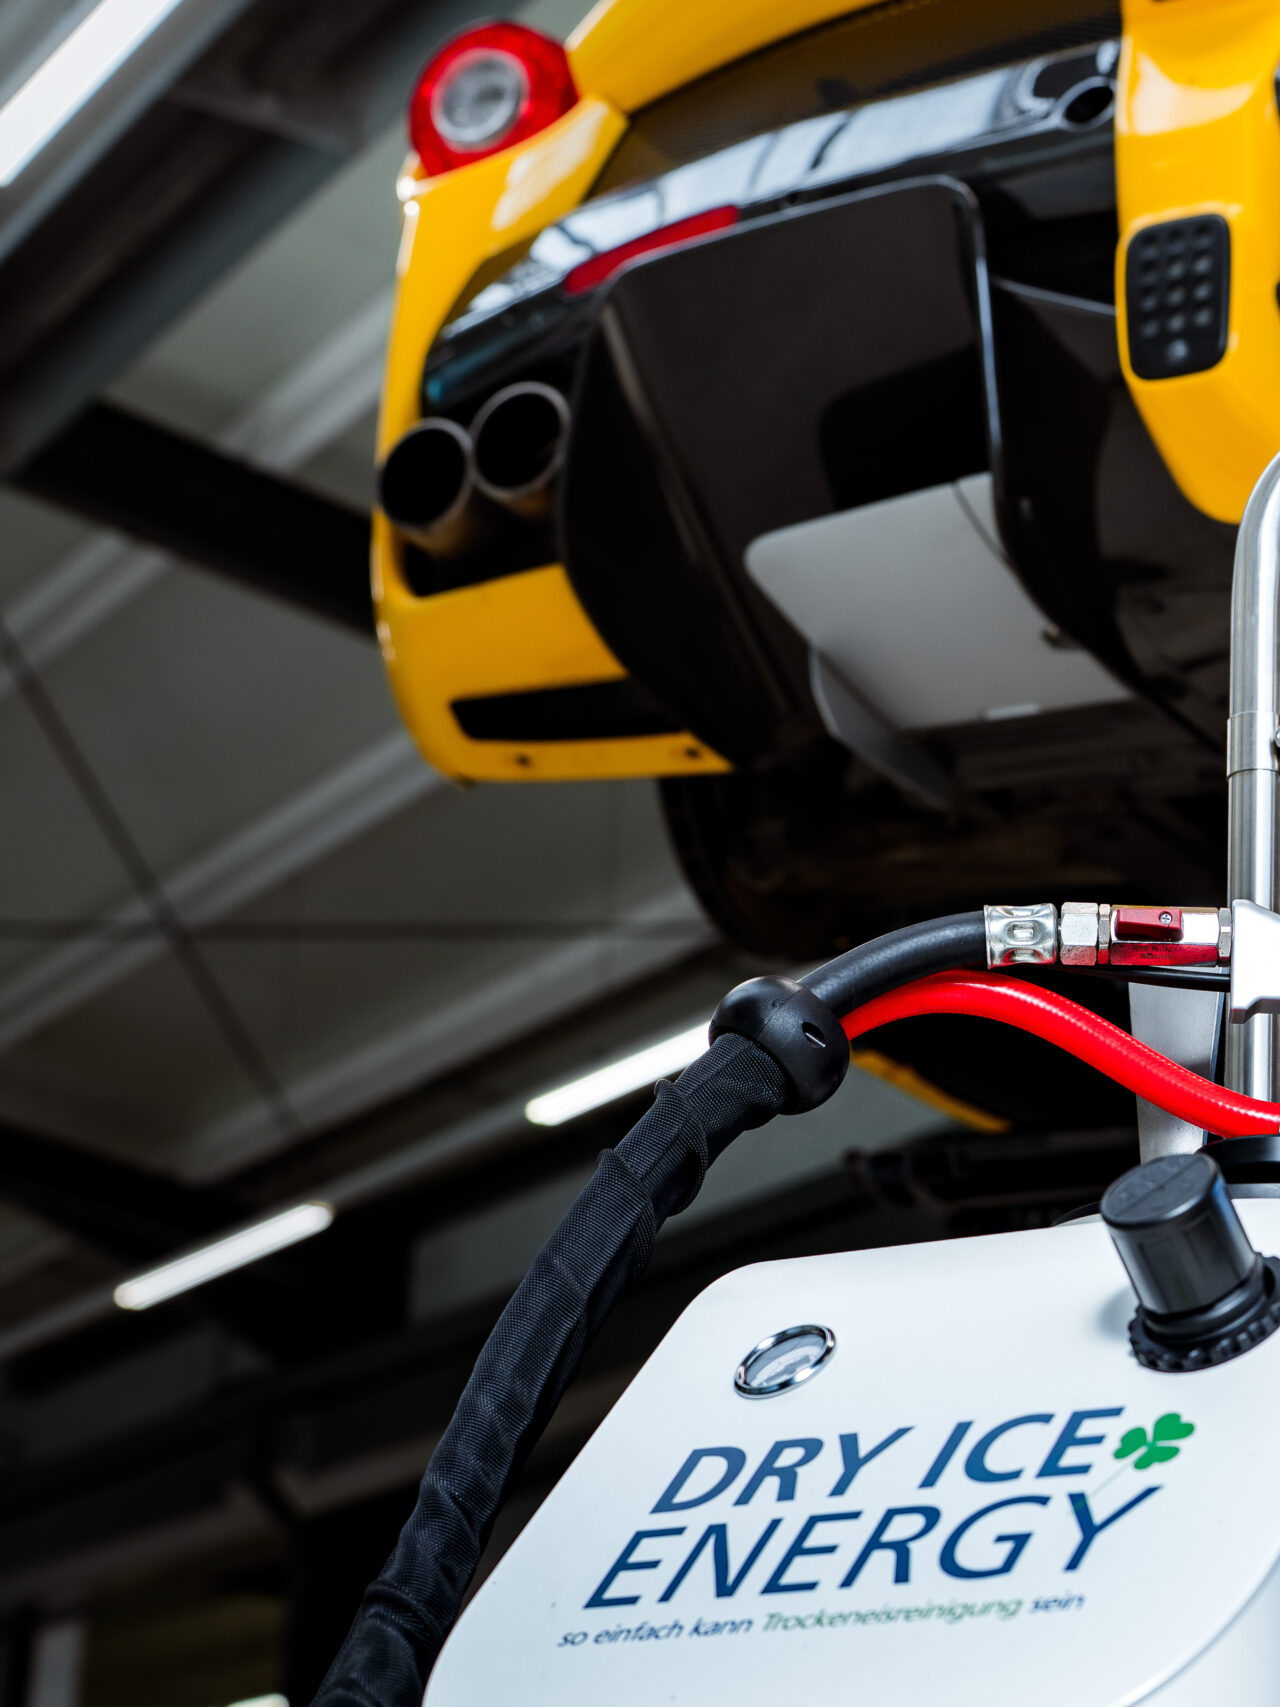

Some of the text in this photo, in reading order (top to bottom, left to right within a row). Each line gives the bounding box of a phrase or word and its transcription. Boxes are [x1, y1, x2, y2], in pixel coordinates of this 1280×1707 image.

[649, 1406, 1126, 1515] DRY ICE
[582, 1485, 1163, 1610] ENERGY
[556, 1591, 1085, 1648] so einfach kann Trockeneisreinigung sein
